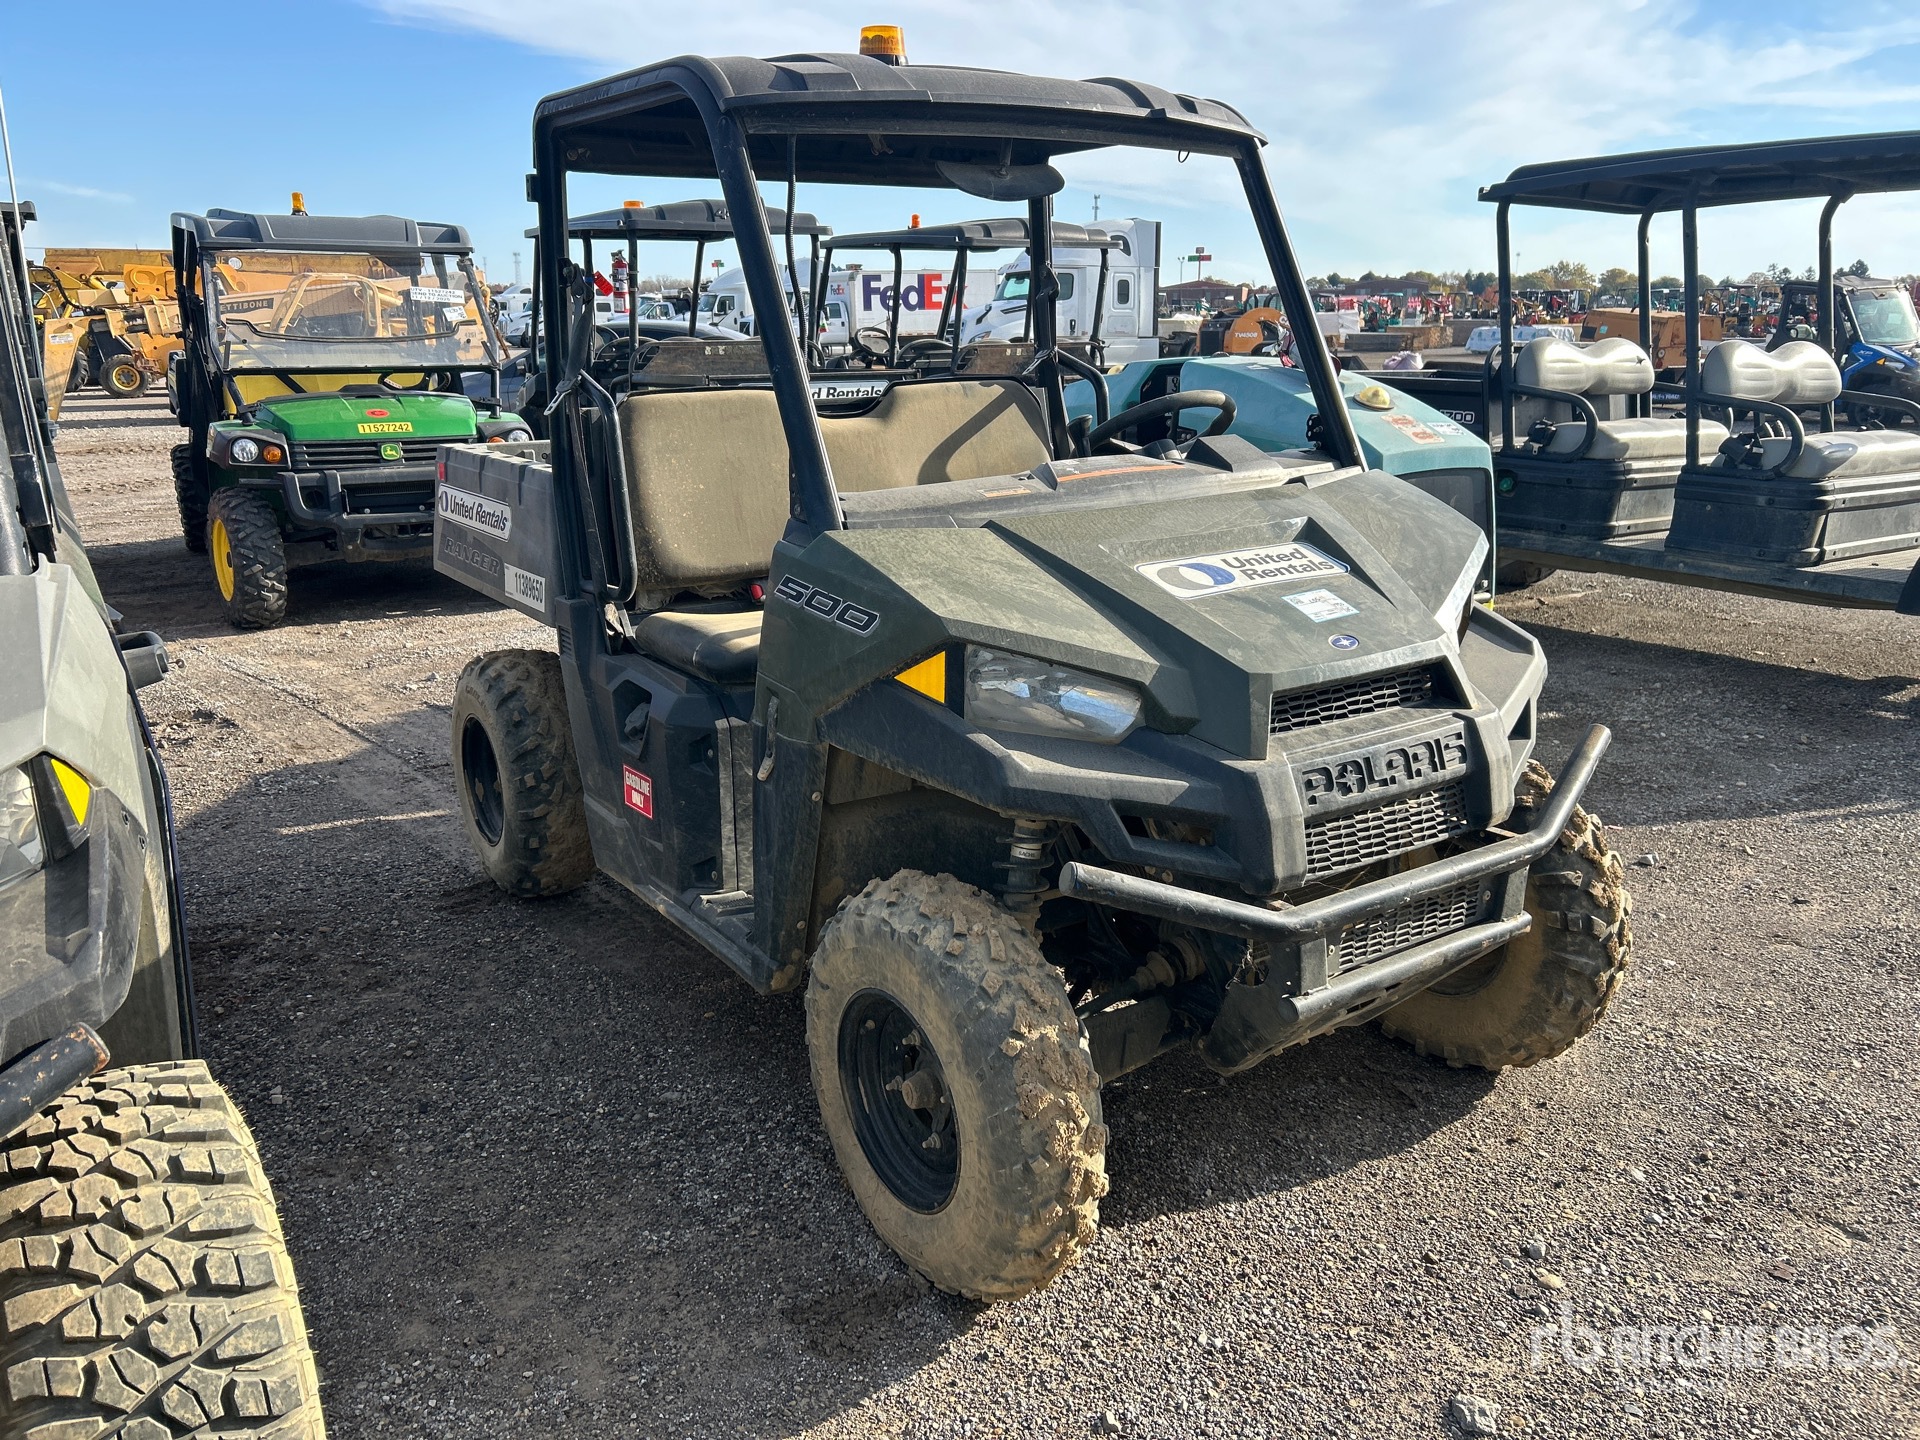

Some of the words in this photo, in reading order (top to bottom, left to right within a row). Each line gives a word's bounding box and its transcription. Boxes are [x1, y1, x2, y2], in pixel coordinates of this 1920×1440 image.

[830, 284, 845, 296] FedEx
[220, 300, 268, 312] ETTIBONE
[826, 385, 882, 398] Rentals
[360, 423, 410, 433] 11527242
[449, 494, 475, 520] United
[476, 502, 508, 532] Rentals
[444, 537, 500, 577] RANGER
[1220, 548, 1306, 569] United
[1239, 560, 1335, 581] Rentals
[514, 572, 543, 604] 11389650
[774, 574, 880, 636] 500
[1302, 731, 1468, 806] POLARIS
[625, 770, 650, 796] GASOLINE
[631, 789, 645, 809] ONLY
